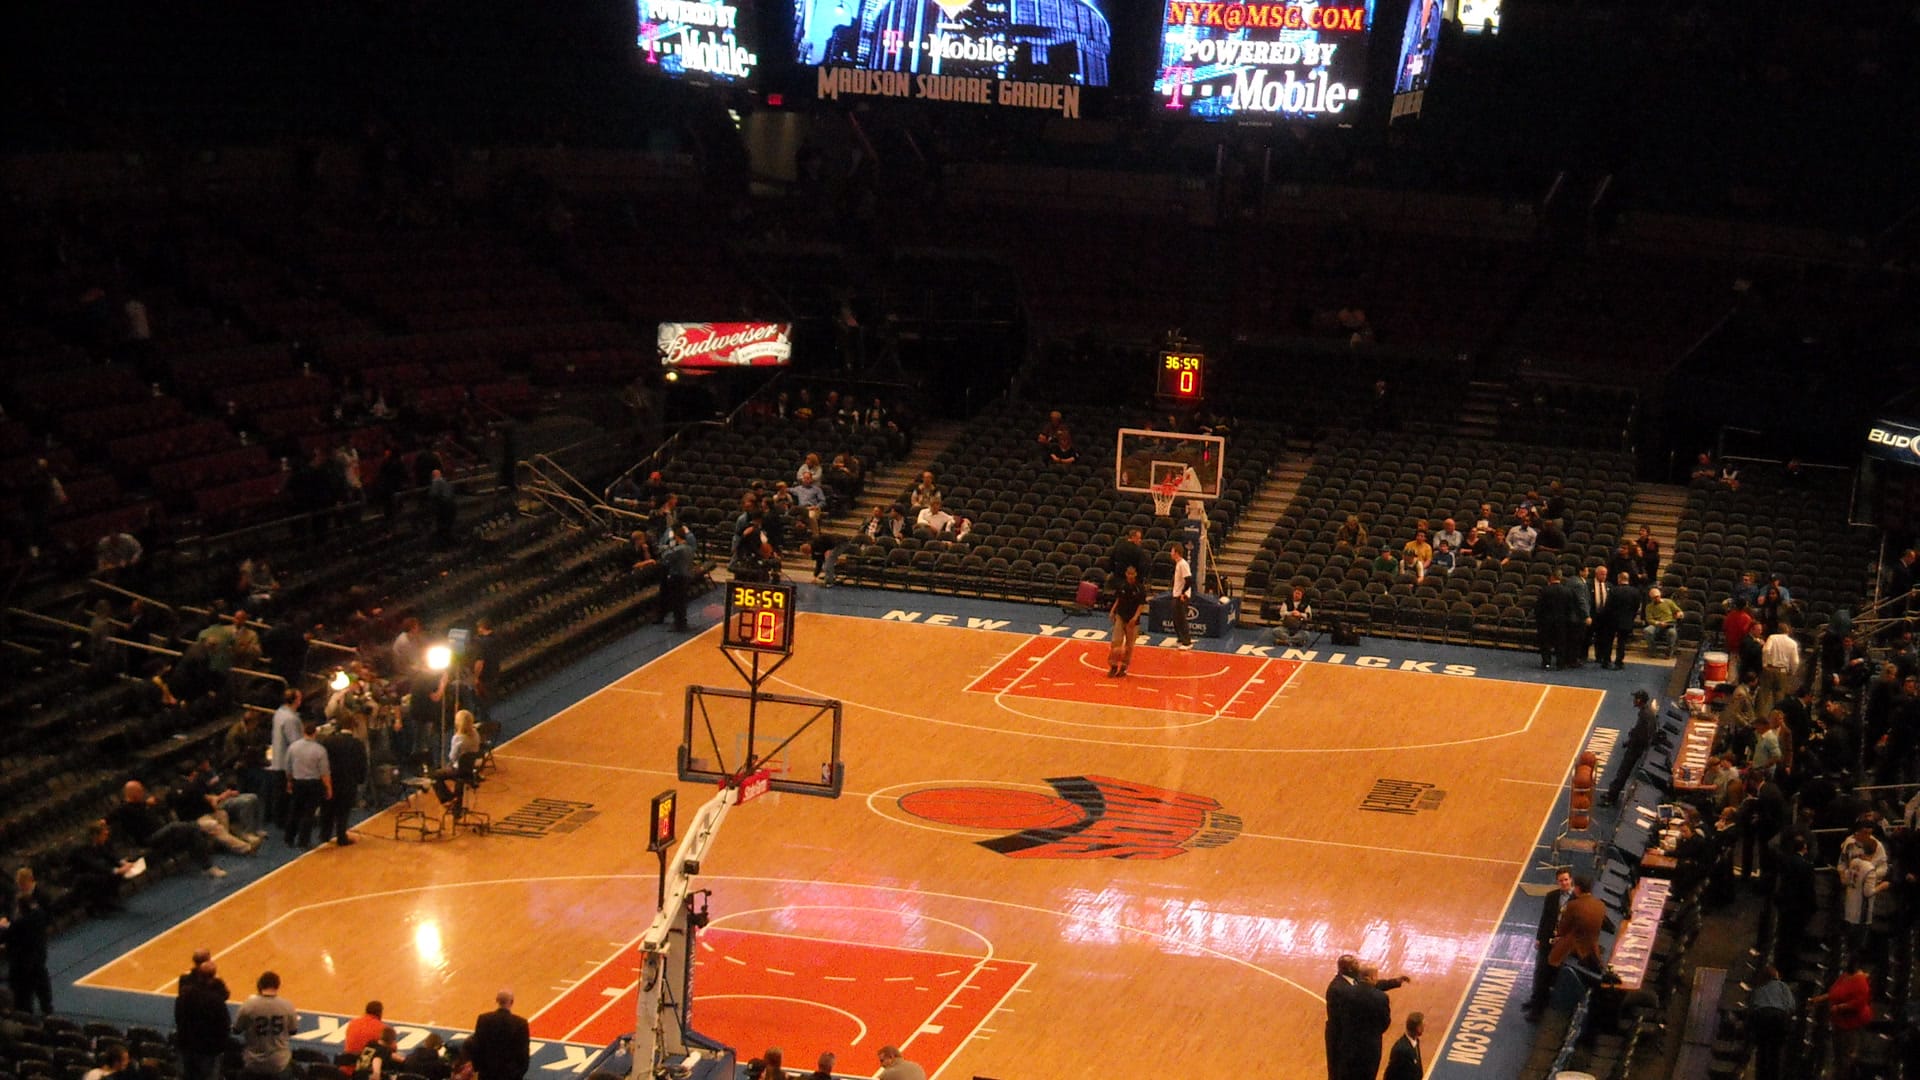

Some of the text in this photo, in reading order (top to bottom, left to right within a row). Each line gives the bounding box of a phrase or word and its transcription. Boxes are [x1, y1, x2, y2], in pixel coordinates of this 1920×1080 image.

[1166, 2, 1364, 31] NYK@MSG.COM
[680, 26, 750, 78] Mobile
[928, 33, 1006, 62] Mobile
[1181, 39, 1337, 66] POWERED BY
[817, 66, 1081, 119] MADISON SQUARE GARDEN
[1229, 67, 1346, 113] Mobile
[660, 323, 778, 365] Budweiser
[1165, 355, 1199, 370] 36:59
[1180, 371, 1193, 393] 0
[734, 587, 785, 609] 36:59
[757, 611, 776, 642] 0
[880, 609, 1011, 631] NEW
[1234, 643, 1478, 677] KNICKS
[254, 1015, 285, 1036] 25
[1446, 966, 1520, 1066] NYKNICKS.COM
